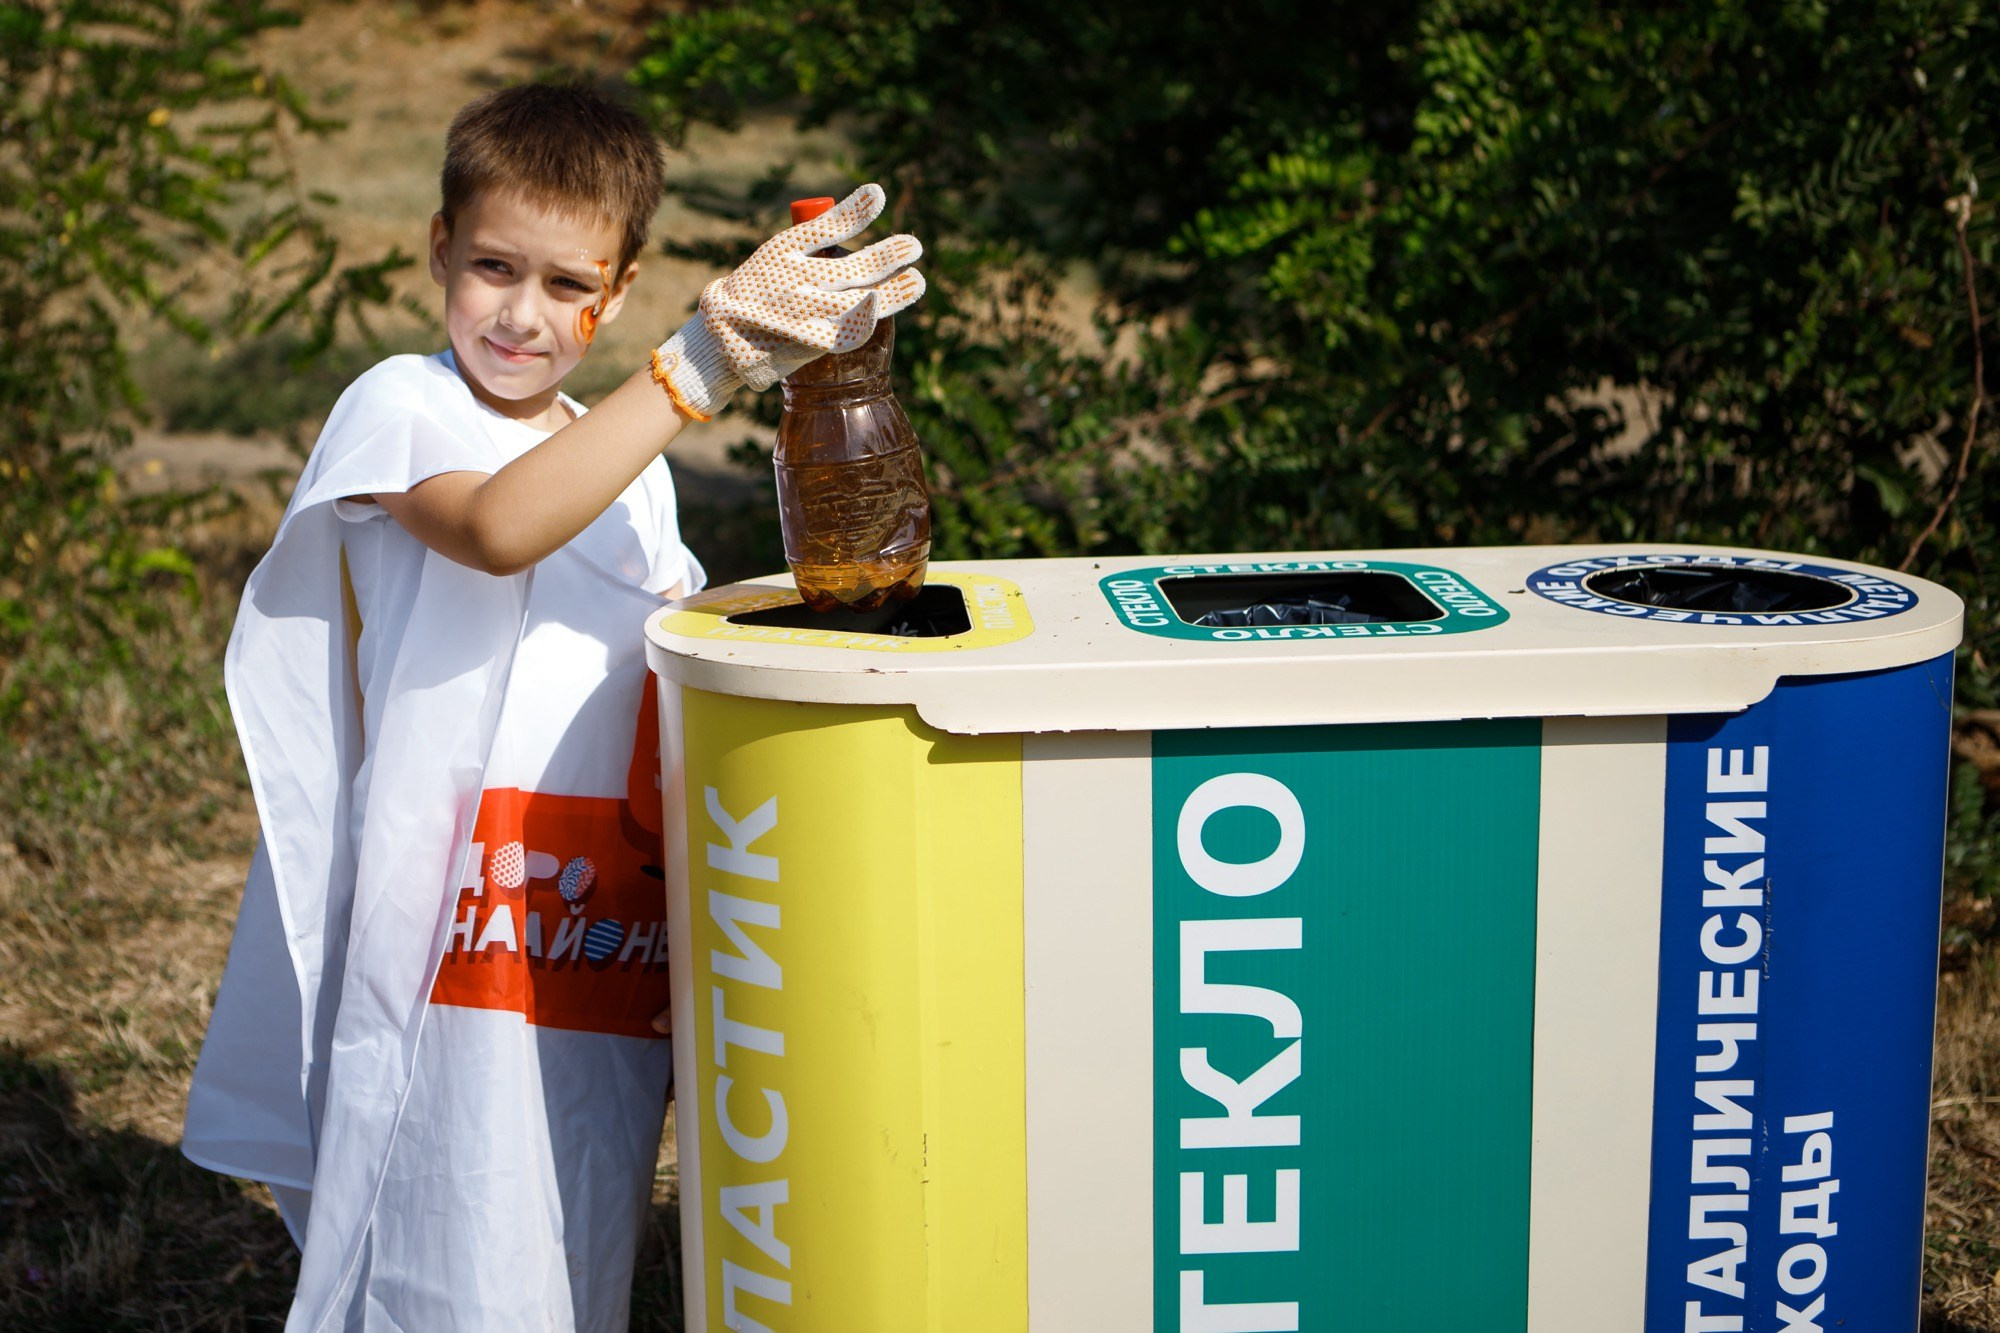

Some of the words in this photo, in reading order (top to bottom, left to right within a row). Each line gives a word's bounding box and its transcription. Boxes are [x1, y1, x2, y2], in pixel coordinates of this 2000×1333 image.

[1163, 560, 1368, 575] СТЕКЛО
[1107, 580, 1169, 627] СТЕКЛО
[1414, 571, 1498, 616] СТЕКЛО
[1536, 573, 1910, 625] МЕТАЛЛИЧЕСКИЕ
[706, 627, 903, 649] ПЛАСТИК
[1211, 623, 1442, 640] СТЕКЛО
[1177, 772, 1306, 1333] ТЕКЛО
